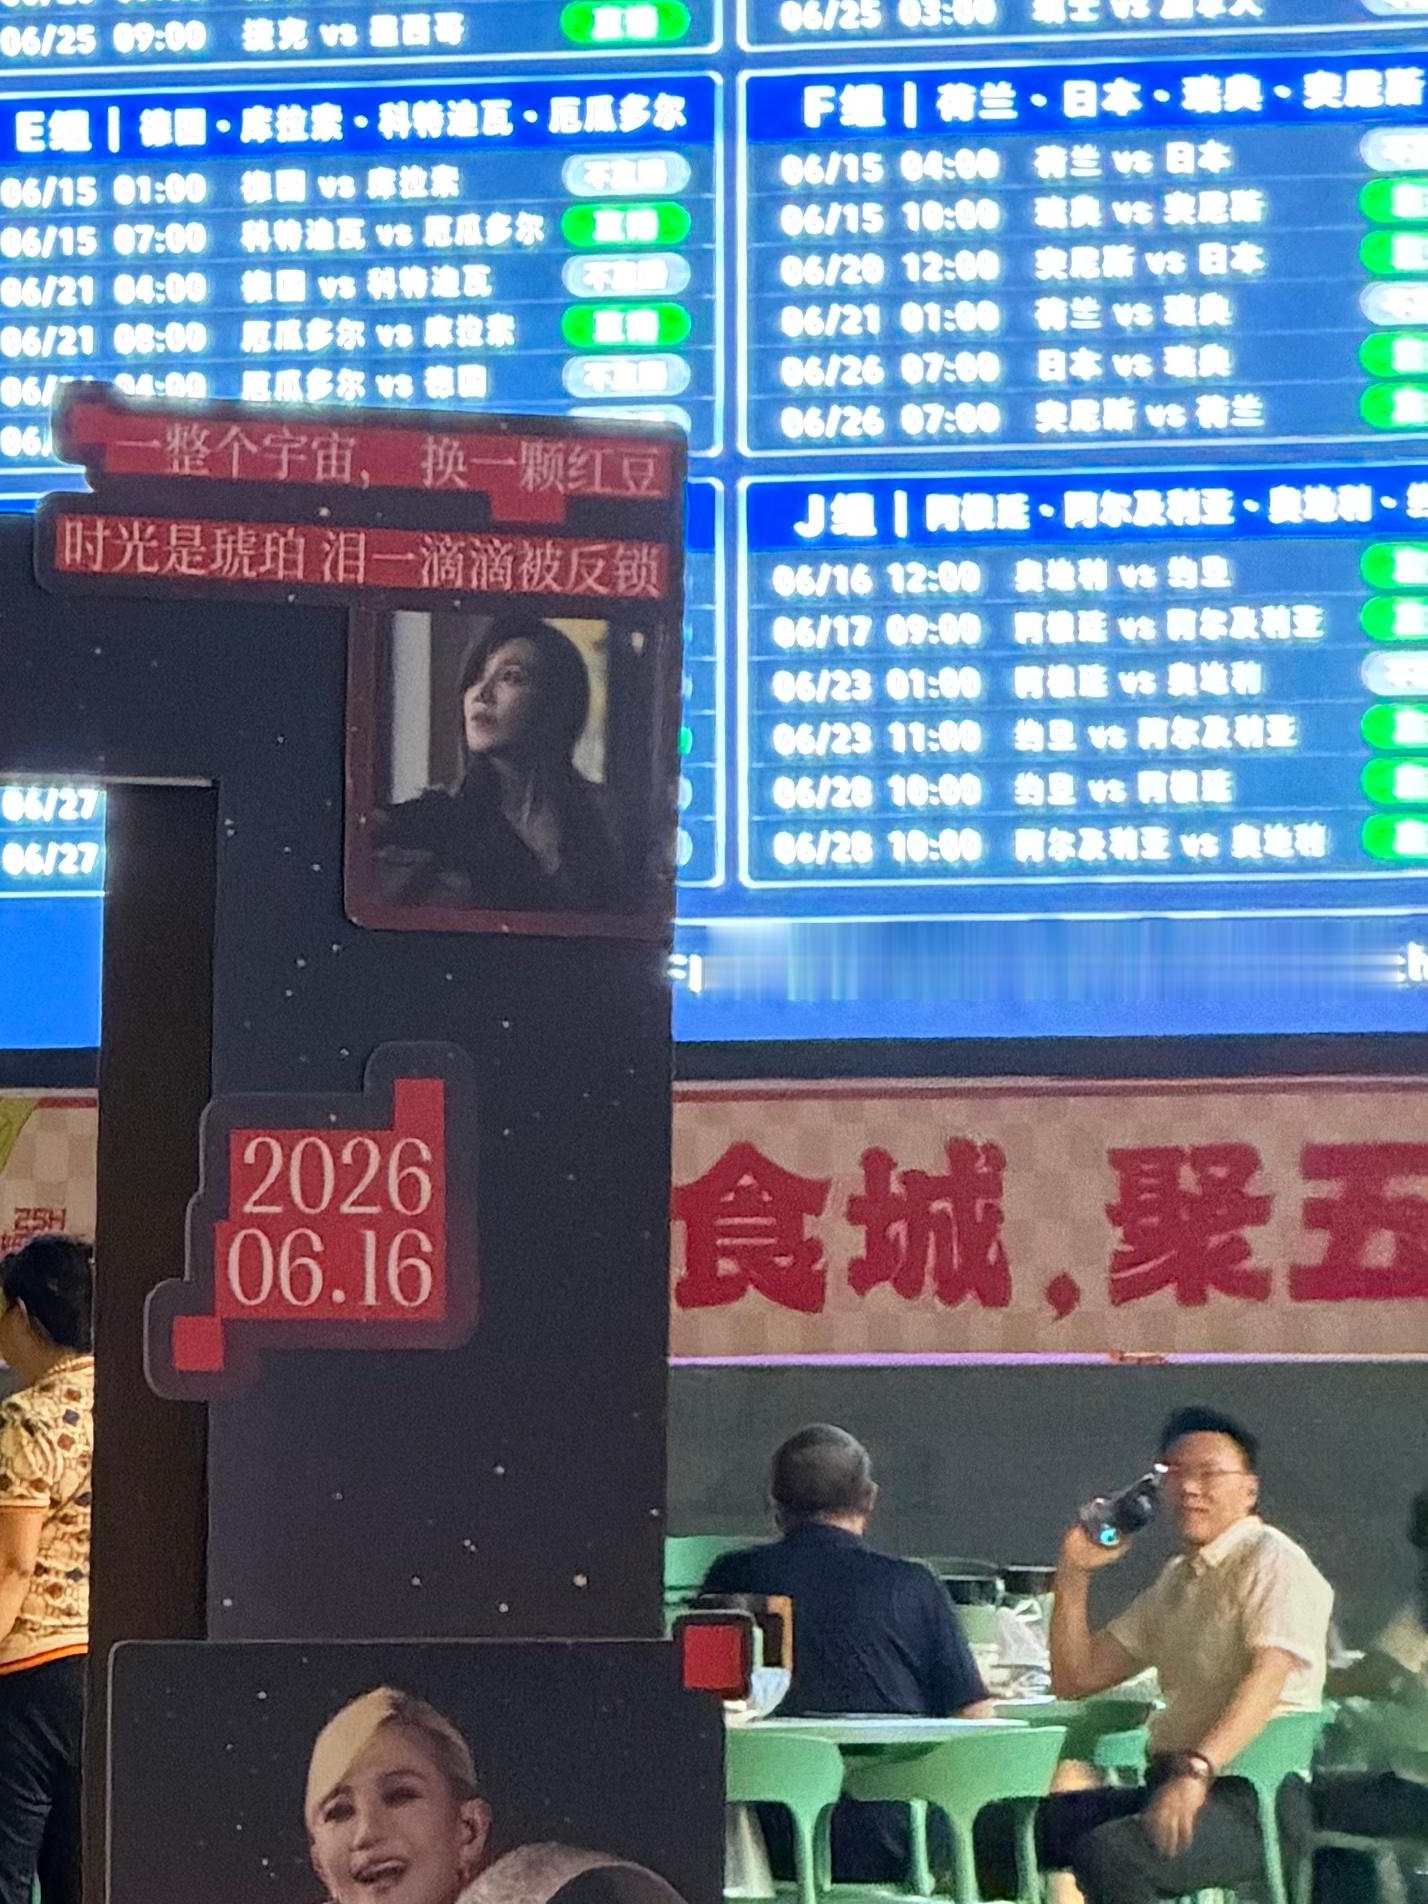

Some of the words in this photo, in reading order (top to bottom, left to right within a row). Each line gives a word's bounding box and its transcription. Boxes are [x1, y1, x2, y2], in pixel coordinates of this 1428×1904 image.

[0, 23, 97, 57] 06/25
[319, 23, 359, 47] vs
[1063, 77, 1142, 118] 日本
[779, 151, 885, 187] 06/15
[1111, 150, 1154, 174] vs
[1165, 139, 1232, 175] 日本
[779, 202, 885, 237] 06/15
[1111, 200, 1155, 226] vs
[779, 252, 885, 288] 06/20
[1144, 250, 1187, 277] vs
[1198, 240, 1266, 276] 日本
[779, 303, 881, 338] 06/21
[1111, 302, 1154, 330] vs
[779, 353, 885, 389] 06/26
[1036, 346, 1104, 383] 日本
[1111, 353, 1155, 379] vs
[779, 404, 885, 439] 06/26
[1144, 403, 1187, 428] vs
[1, 842, 99, 876] 06/27
[242, 1136, 433, 1217] 2026
[227, 1227, 433, 1308] 06.16
